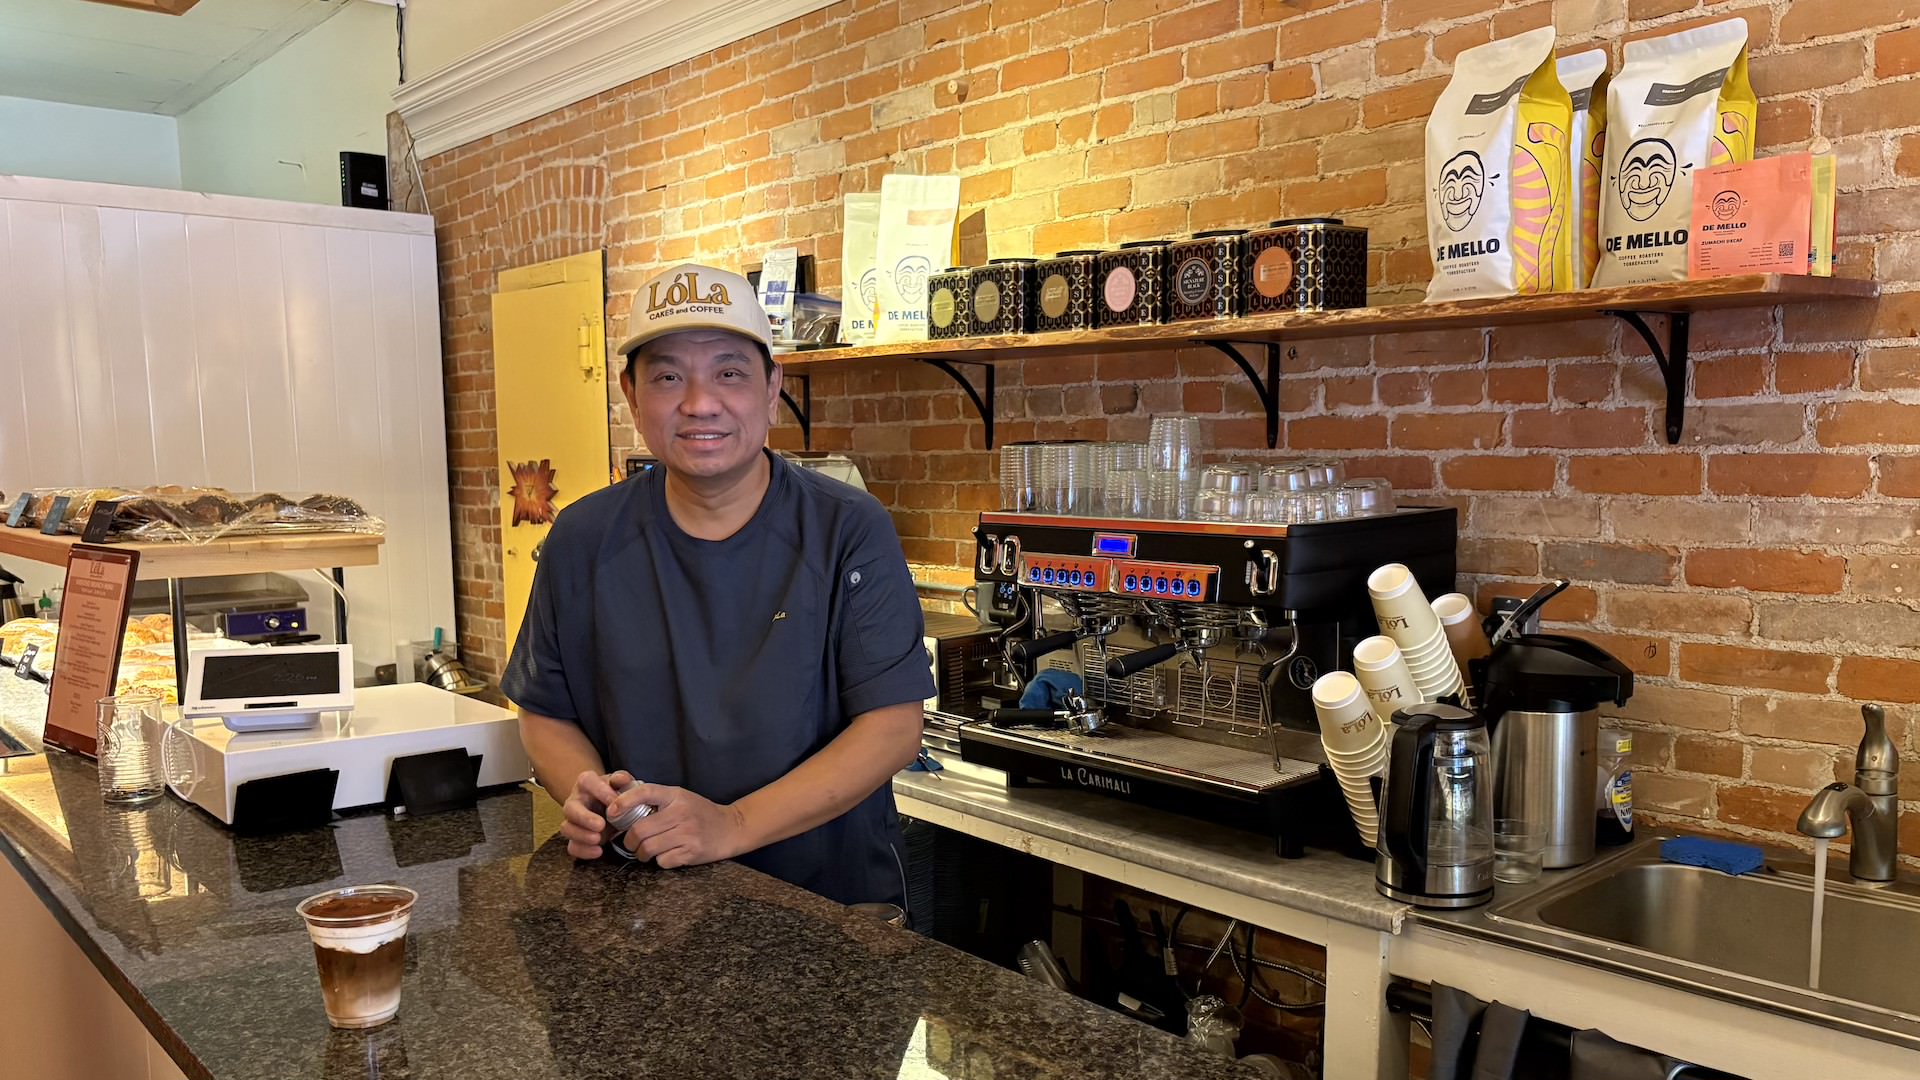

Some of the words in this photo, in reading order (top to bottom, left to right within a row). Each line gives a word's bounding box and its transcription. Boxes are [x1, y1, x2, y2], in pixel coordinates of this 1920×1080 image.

[1717, 222, 1747, 230] MELLO
[1448, 239, 1500, 259] MELLO
[1606, 236, 1622, 252] DE
[1626, 229, 1688, 250] MELLO
[646, 272, 732, 314] LóLa
[650, 308, 675, 320] CAKES
[690, 305, 724, 315] COFFEE
[888, 311, 899, 320] DE
[902, 310, 929, 320] MEL
[852, 320, 865, 329] DE
[1341, 711, 1373, 734] LóLa
[1060, 766, 1073, 780] LA
[1077, 767, 1131, 794] CARIMALI
